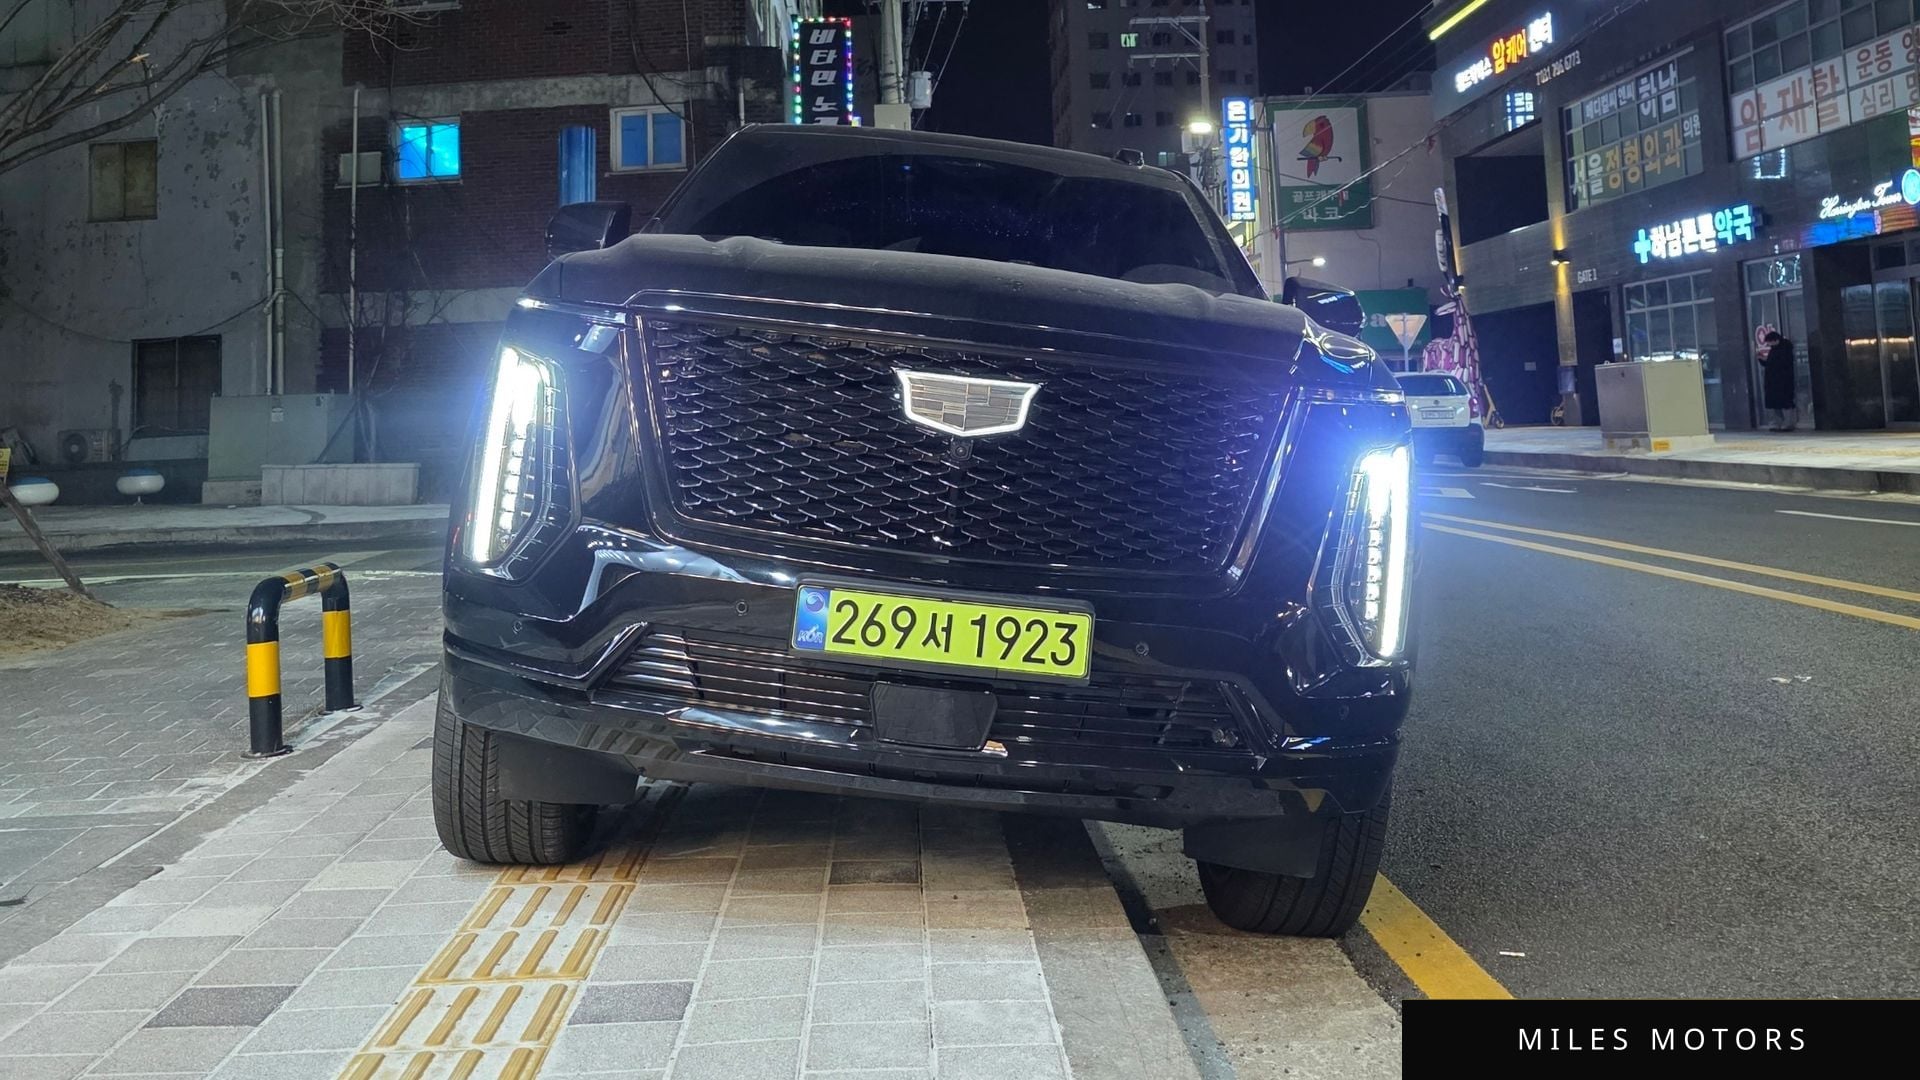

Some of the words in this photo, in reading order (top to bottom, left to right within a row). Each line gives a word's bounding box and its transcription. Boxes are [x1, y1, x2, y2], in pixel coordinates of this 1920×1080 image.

[809, 29, 837, 86] 비타민
[1855, 39, 1893, 80] 운동
[812, 96, 839, 125] 노
[1859, 78, 1897, 118] 심리
[1577, 269, 1593, 284] GATE
[831, 599, 954, 653] 269서
[969, 613, 1079, 667] 1923
